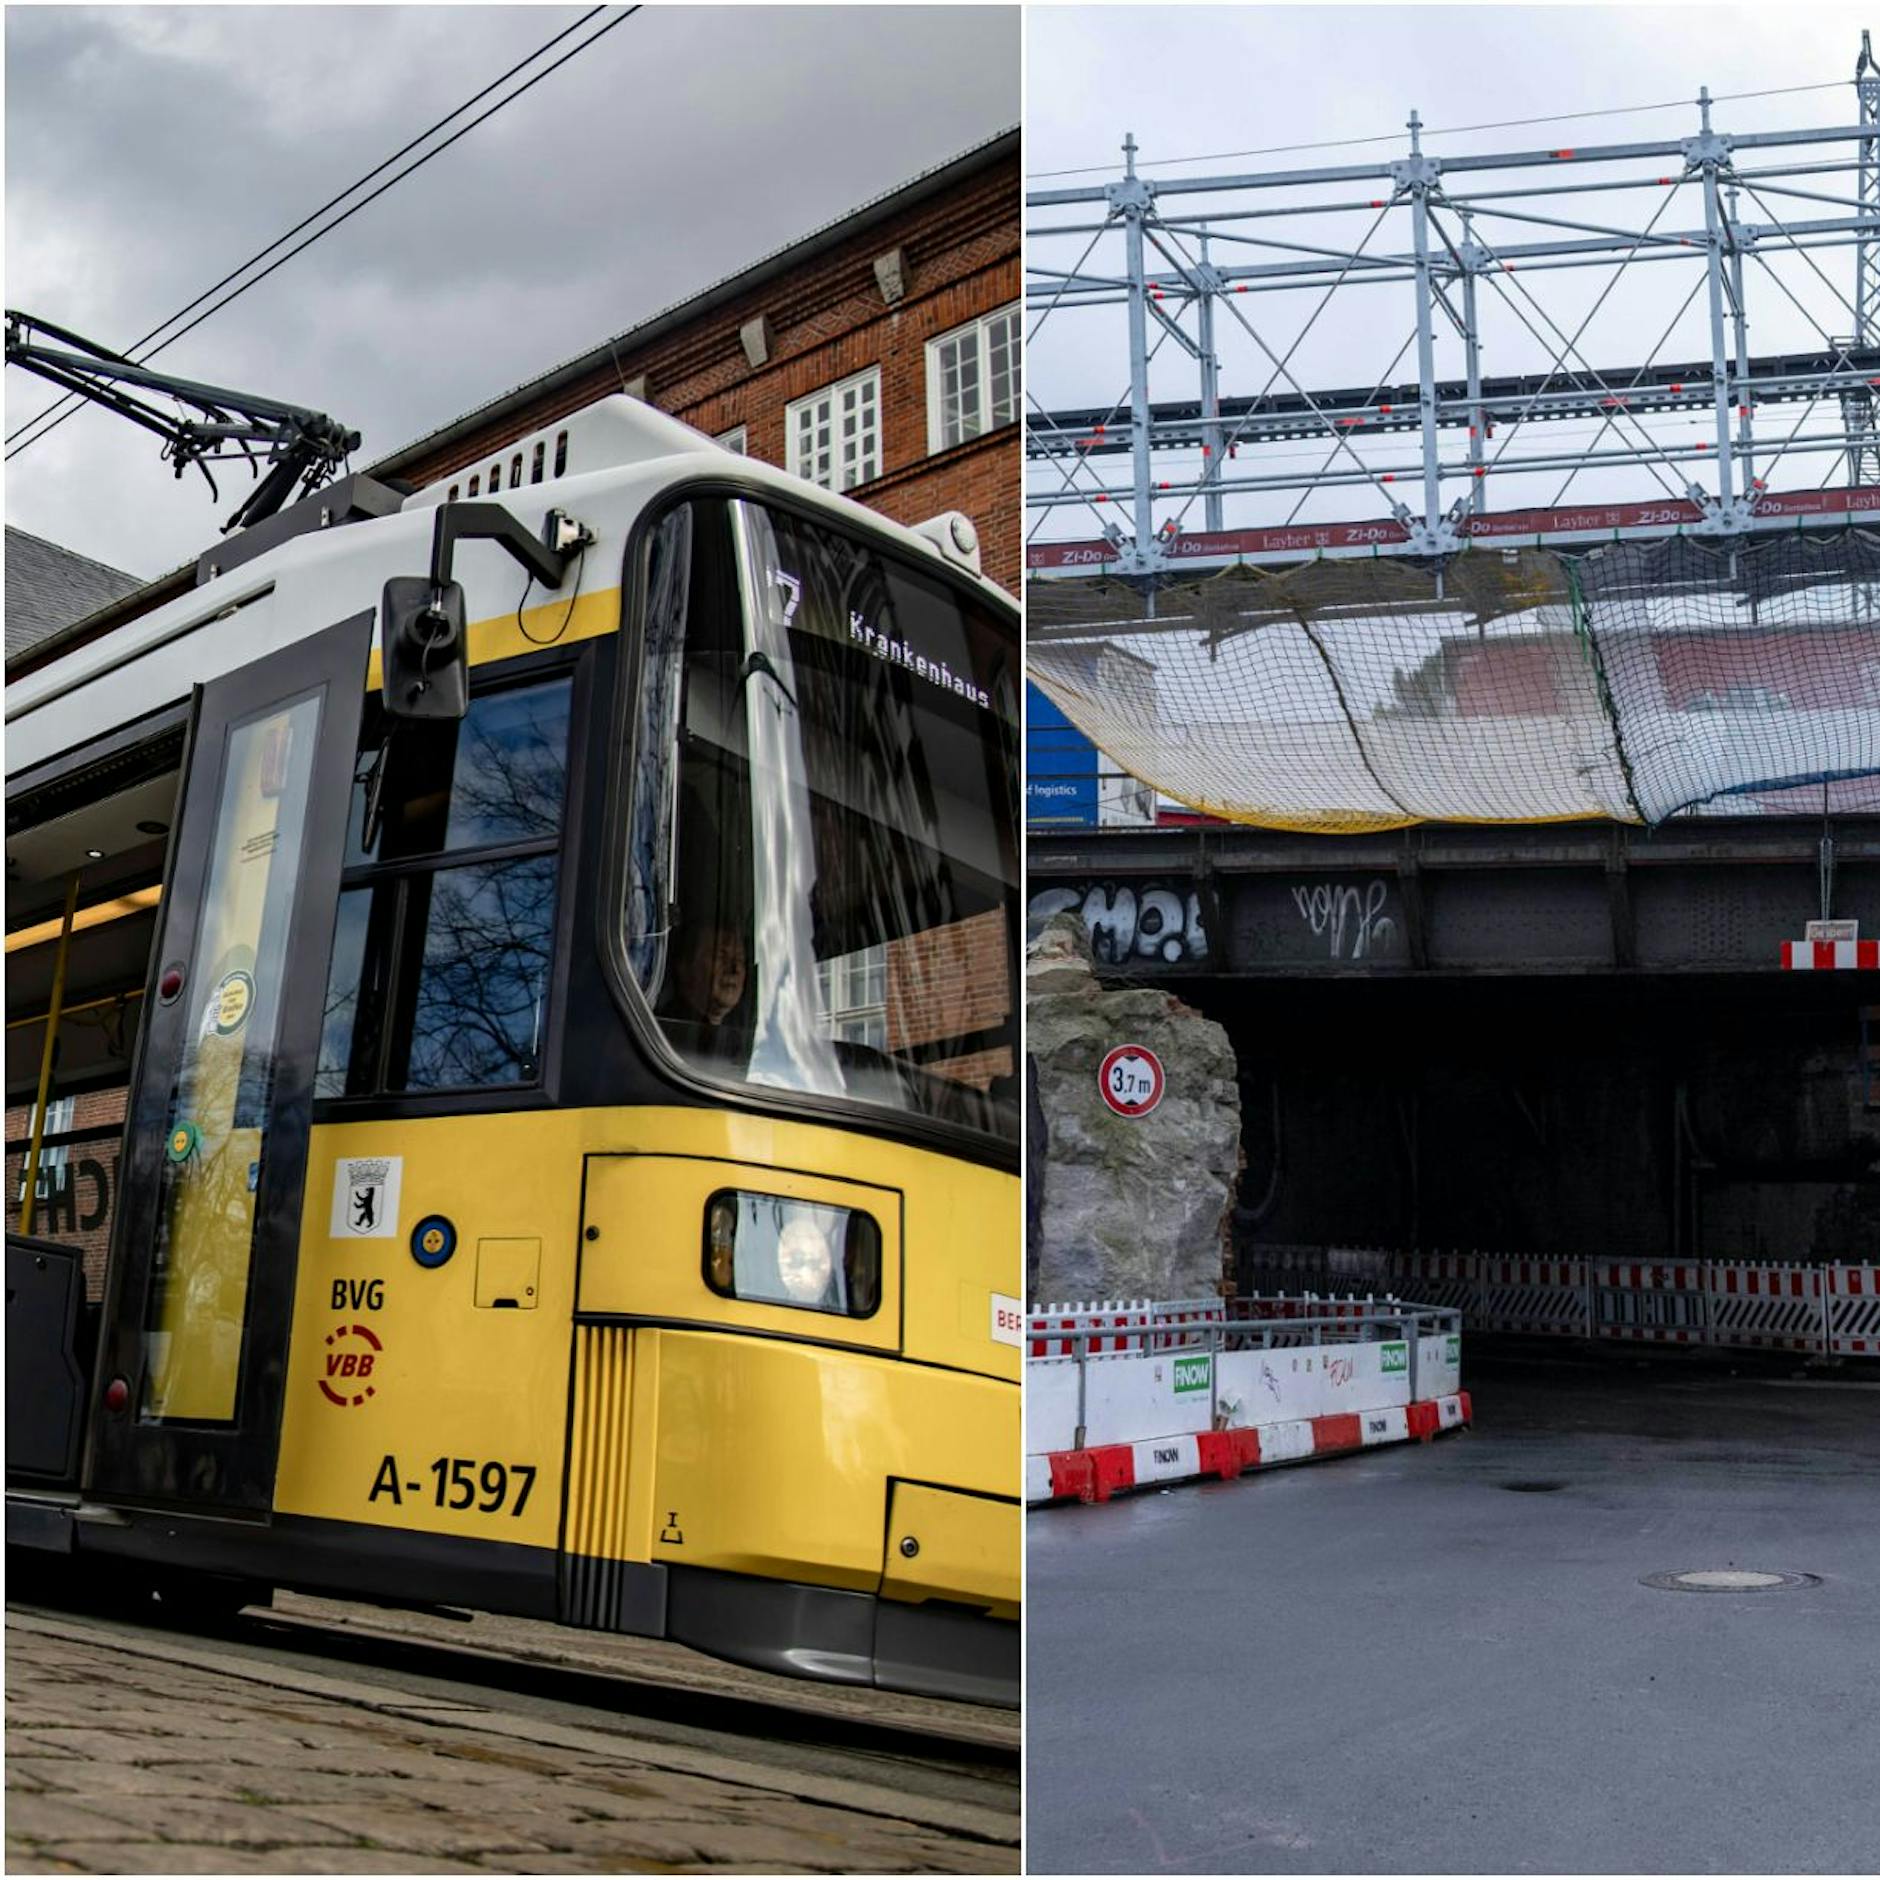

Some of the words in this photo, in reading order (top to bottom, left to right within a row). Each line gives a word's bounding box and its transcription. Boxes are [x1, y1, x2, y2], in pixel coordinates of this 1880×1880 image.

[1171, 541, 1202, 554] i-Do
[1346, 527, 1388, 542] Zi-Do
[1061, 550, 1103, 564] Zi-Do
[849, 610, 990, 709] Krankenhaus
[1034, 785, 1078, 798] logistics
[1138, 1079, 1151, 1094] m
[331, 1278, 385, 1311] BVG
[326, 1353, 375, 1377] VBB
